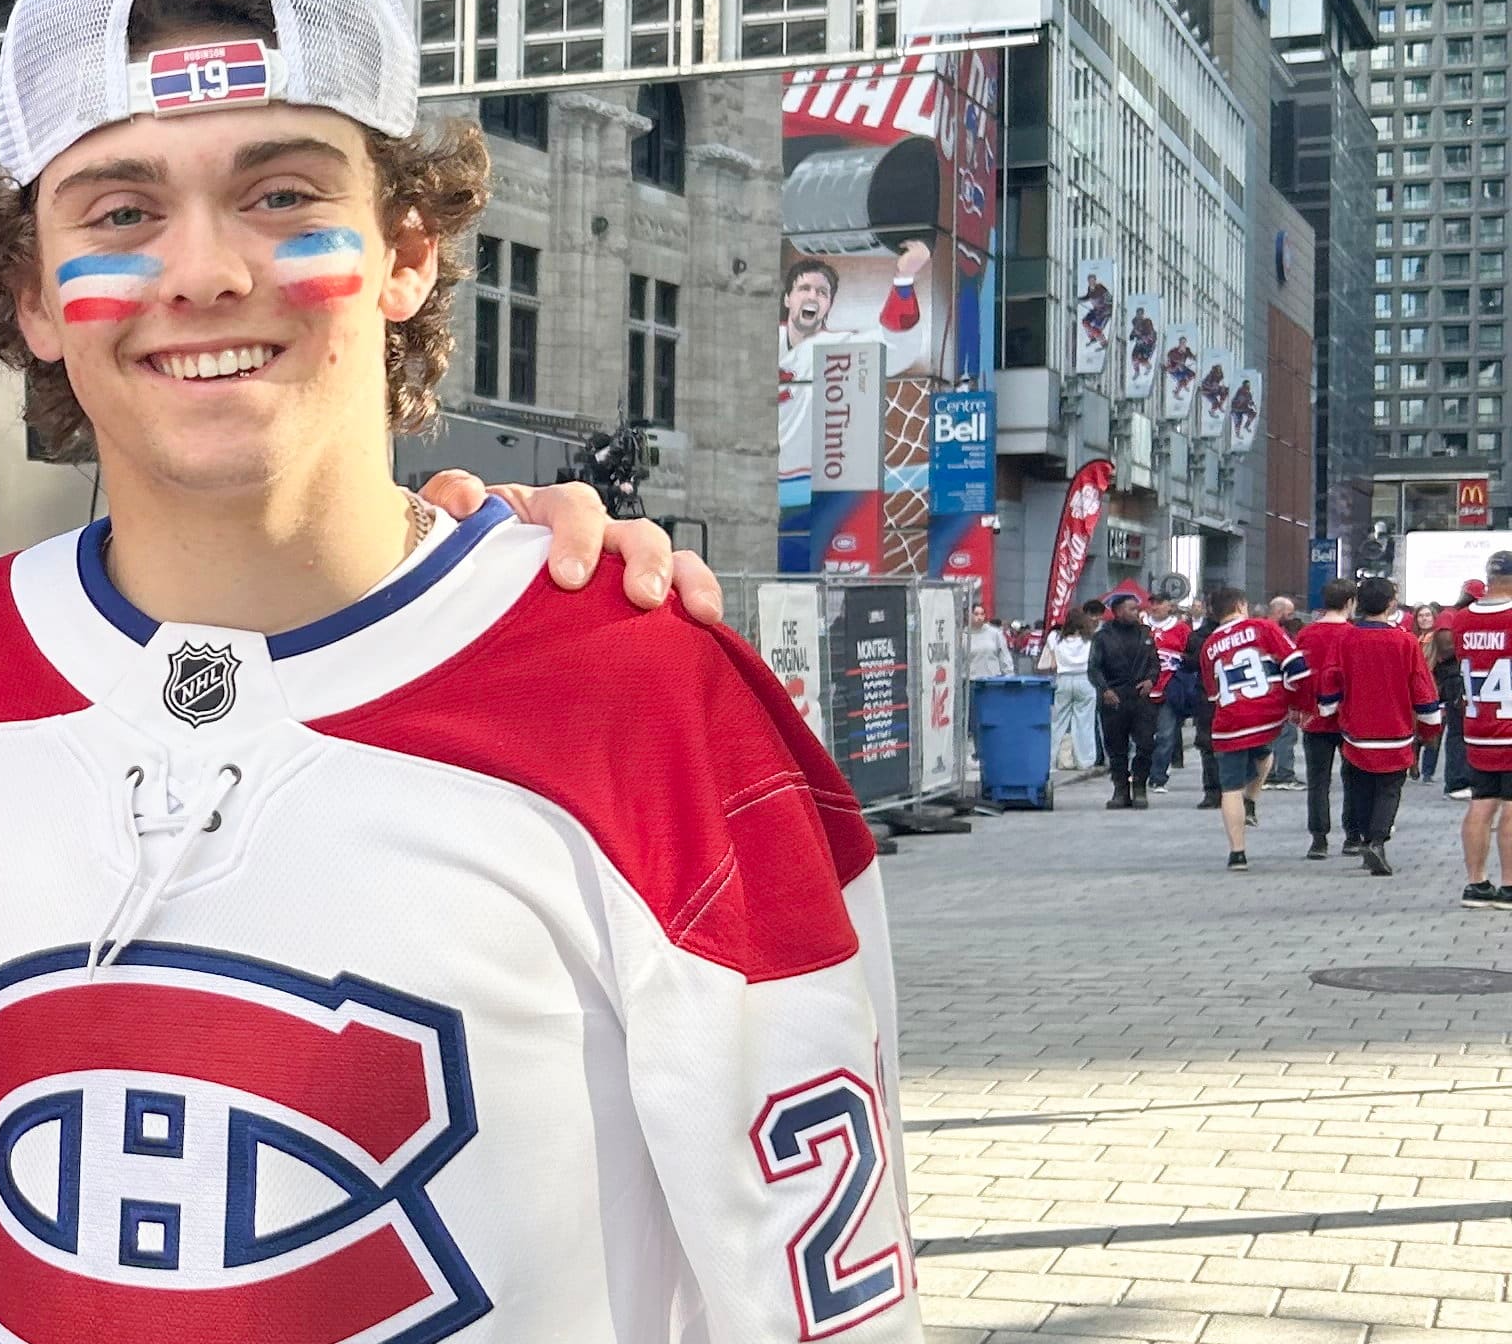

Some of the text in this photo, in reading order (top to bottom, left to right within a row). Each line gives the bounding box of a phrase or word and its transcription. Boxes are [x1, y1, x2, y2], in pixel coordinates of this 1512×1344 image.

[187, 60, 230, 102] 19
[823, 353, 852, 480] Rio Tinto
[934, 397, 987, 413] Centre
[934, 412, 986, 443] Bell
[1311, 548, 1336, 563] Bell
[1207, 627, 1257, 661] CAUFIELD
[1463, 631, 1506, 651] SUZUKI
[181, 667, 222, 705] NHL
[1214, 647, 1270, 708] 13
[1460, 658, 1512, 721] 14
